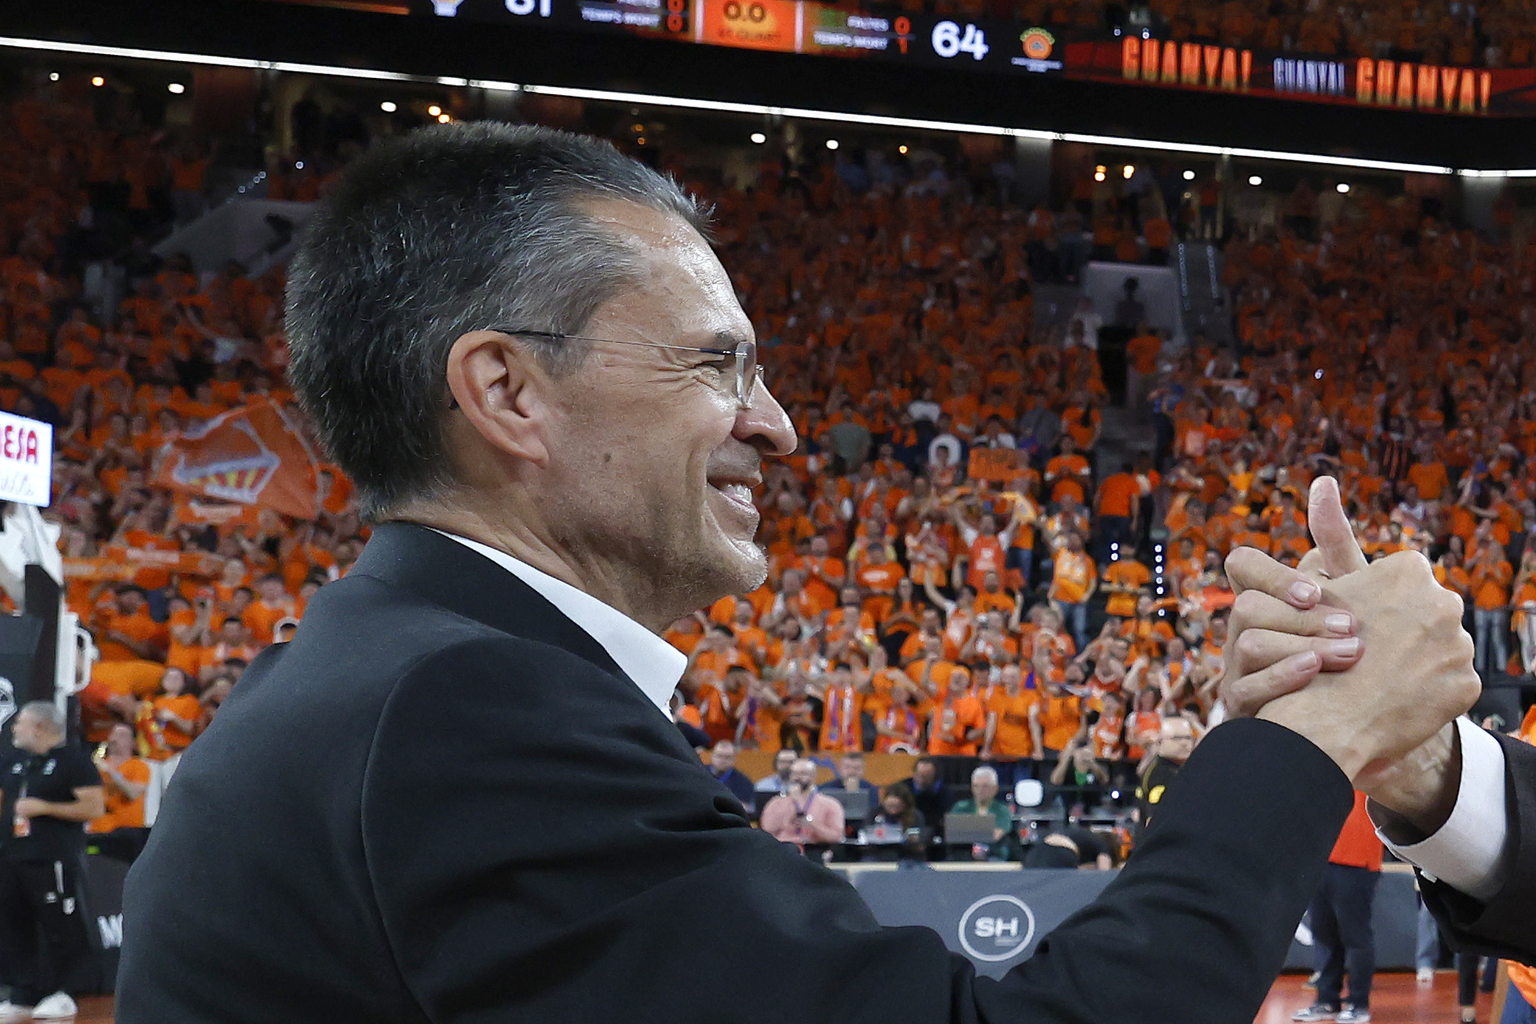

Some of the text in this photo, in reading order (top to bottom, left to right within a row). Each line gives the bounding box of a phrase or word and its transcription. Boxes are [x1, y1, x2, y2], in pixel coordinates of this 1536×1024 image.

[725, 1, 765, 23] 0.0
[932, 20, 989, 60] 64
[0, 425, 38, 464] ESA
[975, 916, 1018, 938] SH
